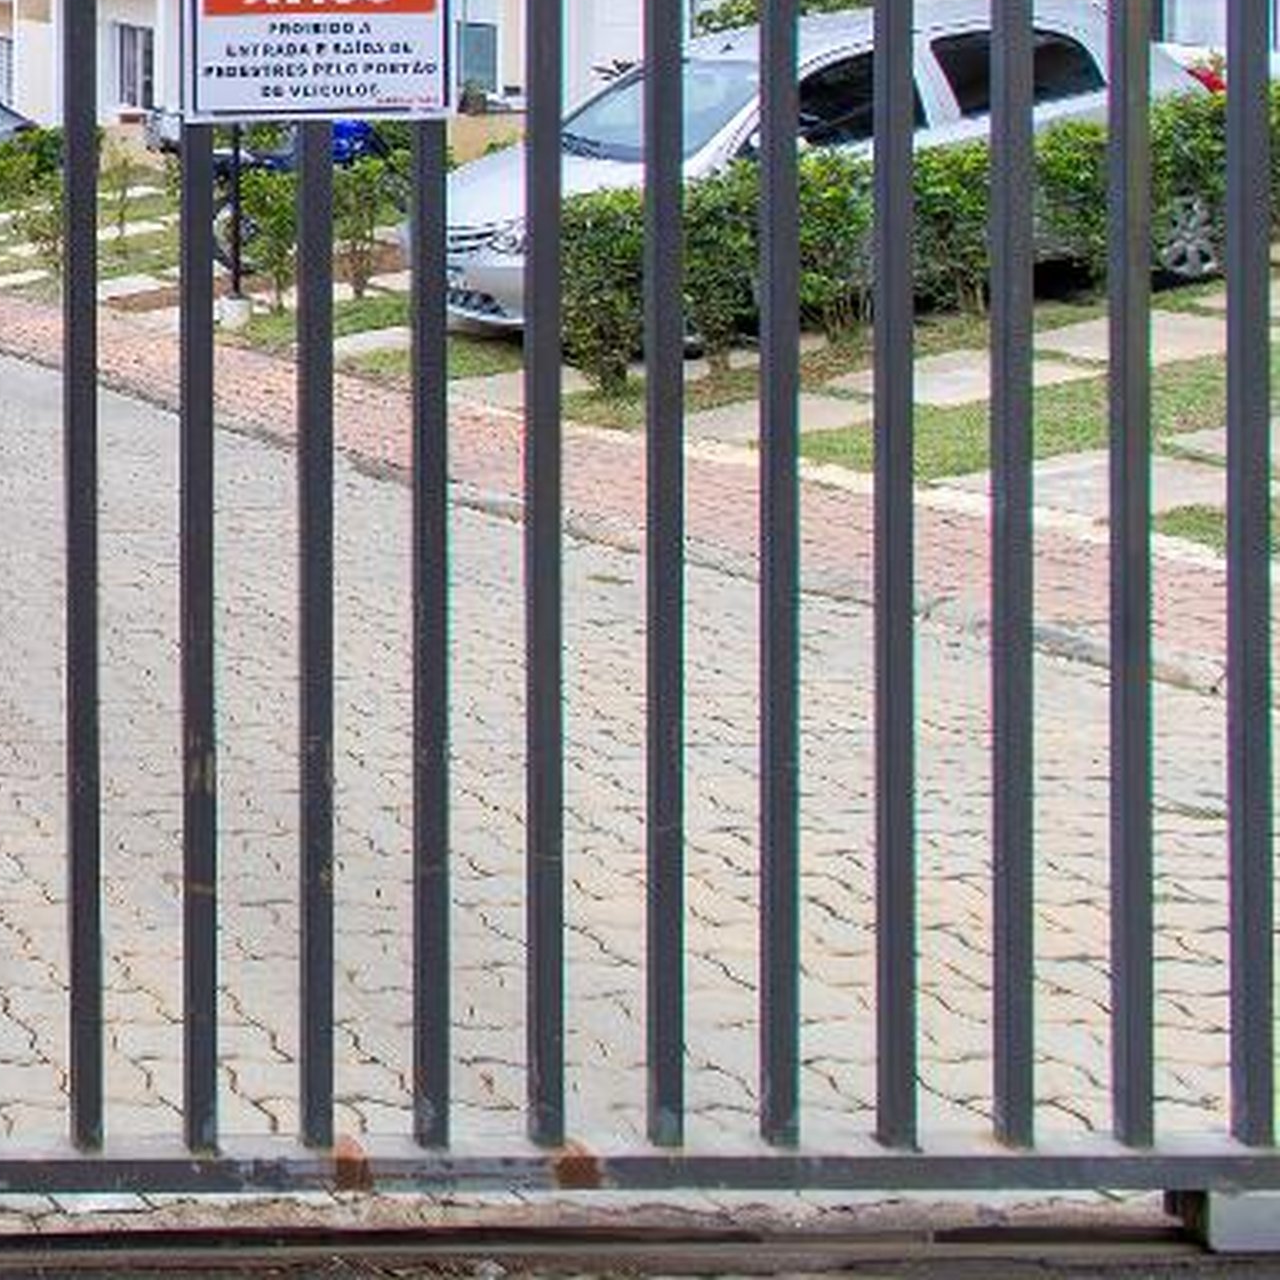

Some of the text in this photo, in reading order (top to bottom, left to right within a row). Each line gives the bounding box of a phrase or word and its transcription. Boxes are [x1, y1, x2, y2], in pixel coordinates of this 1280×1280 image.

[268, 22, 371, 35] PROIBIDO A
[226, 43, 310, 57] ENTRADA
[316, 42, 327, 55] E
[389, 42, 414, 54] DE
[204, 62, 307, 77] PEDESTRES
[313, 62, 357, 77] PELO
[262, 85, 284, 98] DE
